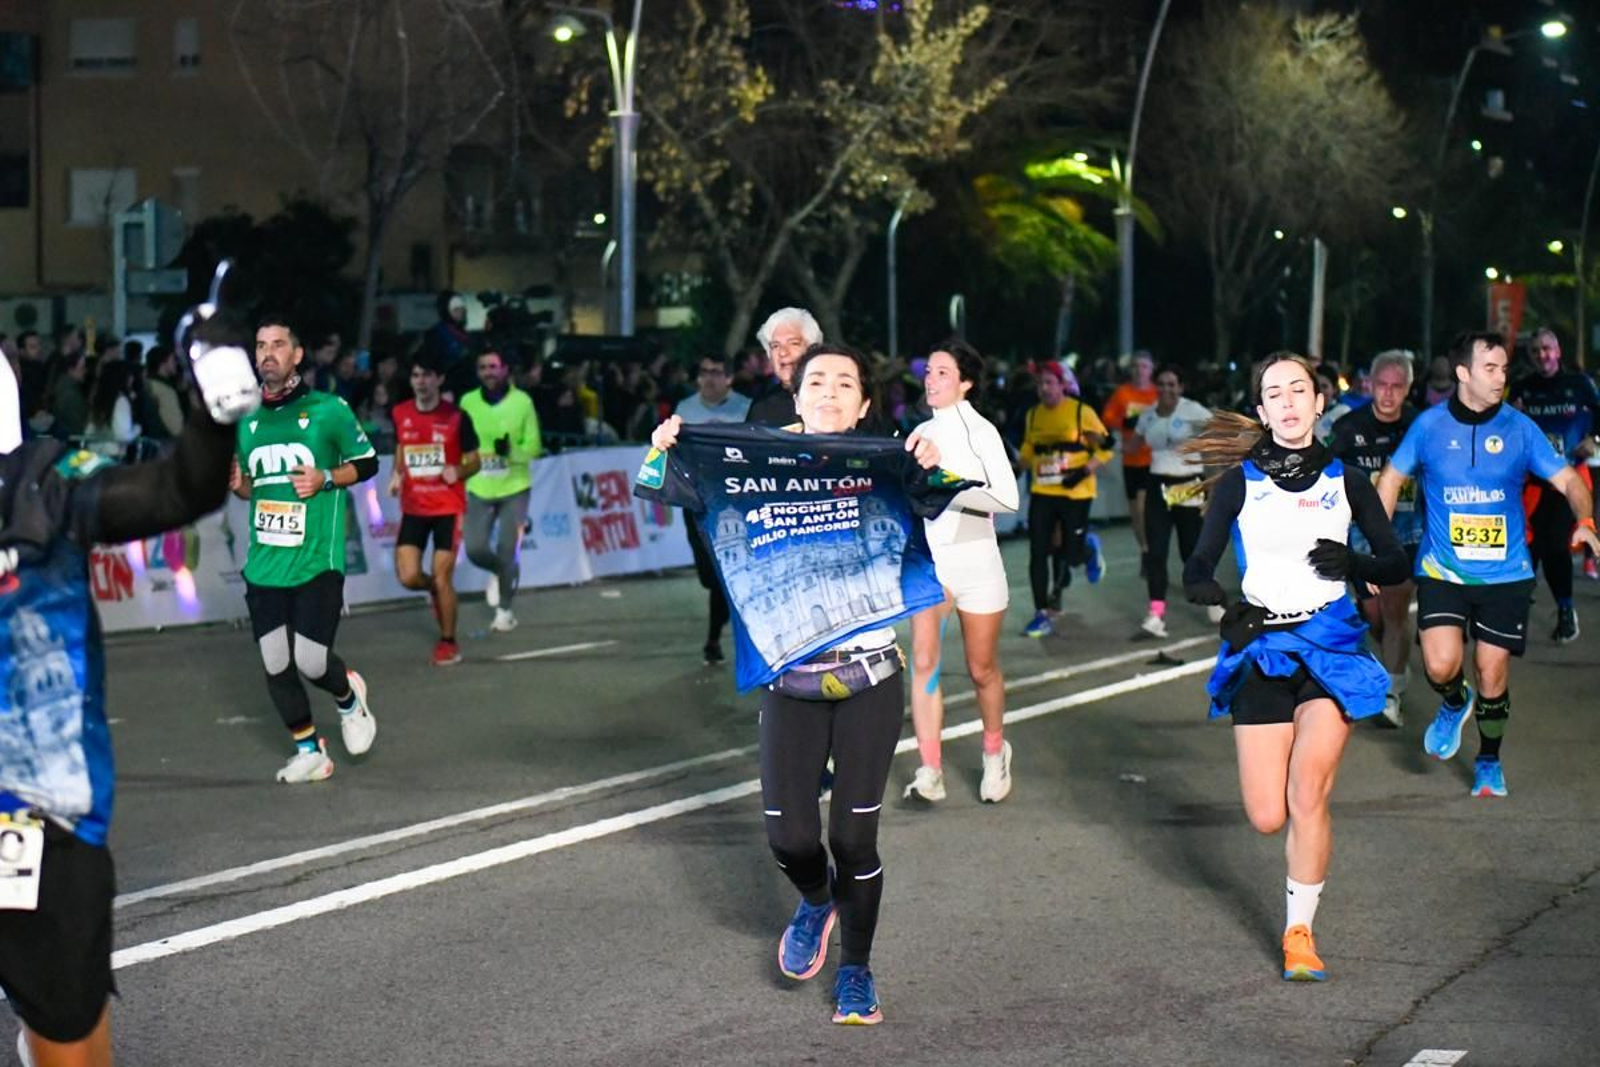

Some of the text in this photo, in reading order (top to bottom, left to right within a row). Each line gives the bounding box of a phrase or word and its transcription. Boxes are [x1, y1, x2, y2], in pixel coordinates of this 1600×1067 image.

[725, 476, 873, 494] SAN ANTÓN
[258, 512, 299, 531] 9715
[746, 508, 772, 524] 42
[773, 503, 832, 515] NOCHE
[836, 499, 858, 509] DE
[763, 508, 859, 529] SAN ANTÓN
[750, 519, 860, 549] JULIO PANCORBO
